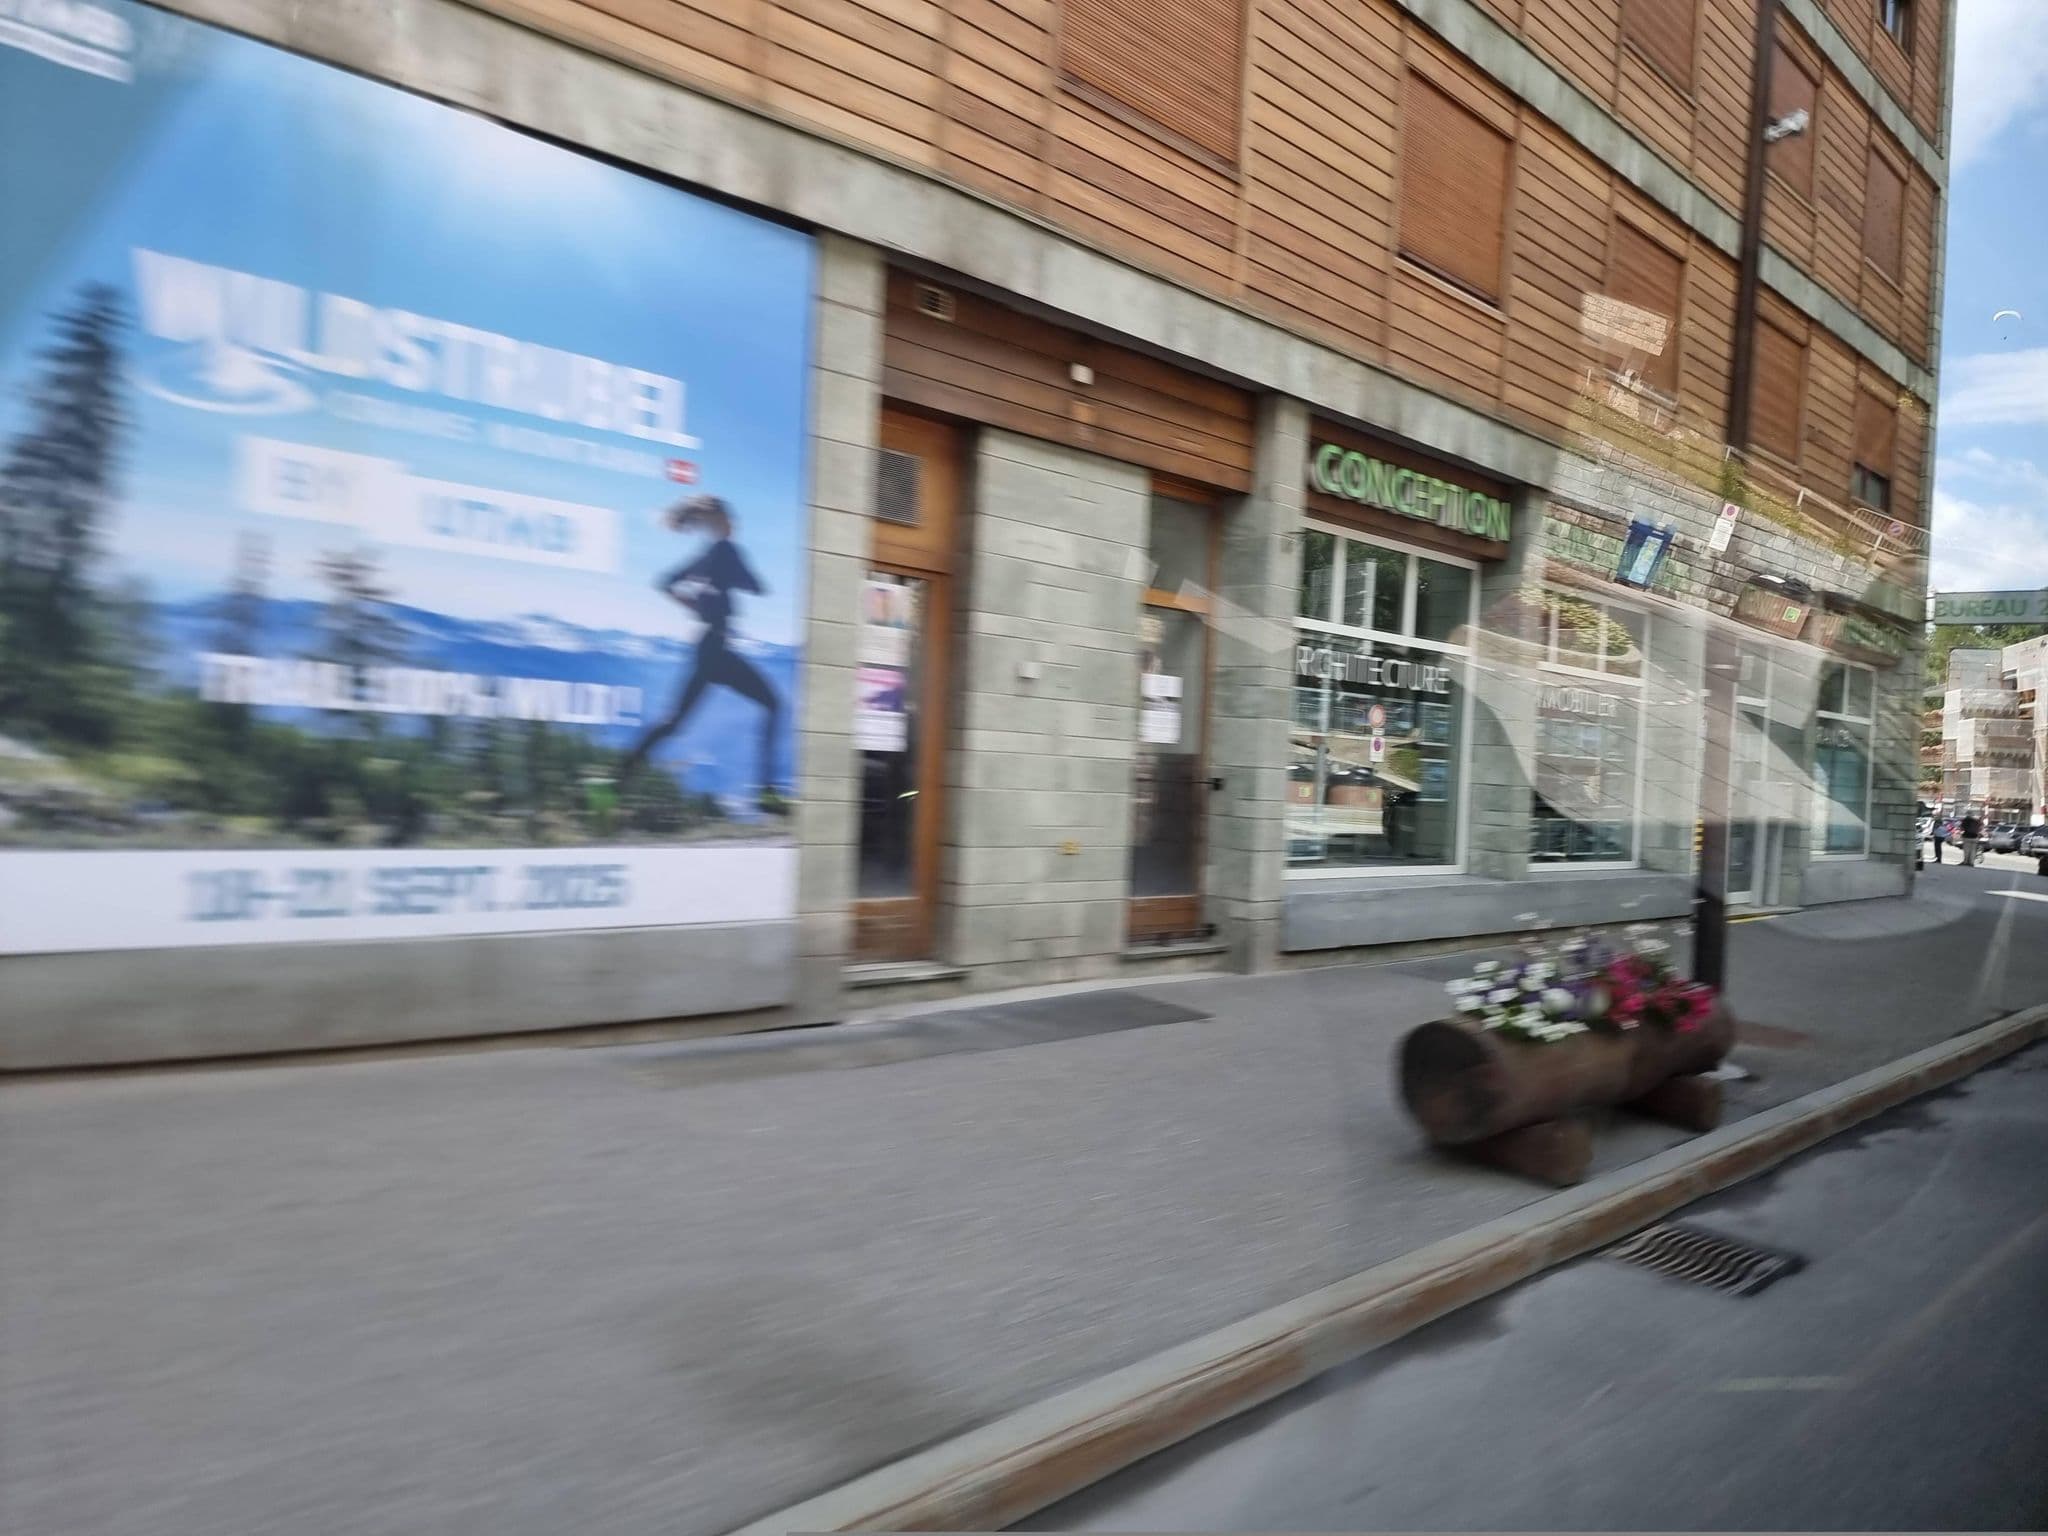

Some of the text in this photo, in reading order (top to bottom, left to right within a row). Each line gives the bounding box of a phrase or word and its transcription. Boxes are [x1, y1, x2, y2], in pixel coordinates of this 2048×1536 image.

[1314, 443, 1512, 541] CONCEPTION
[1935, 599, 2028, 617] BUREAU
[1296, 645, 1451, 694] RCHITECTURE
